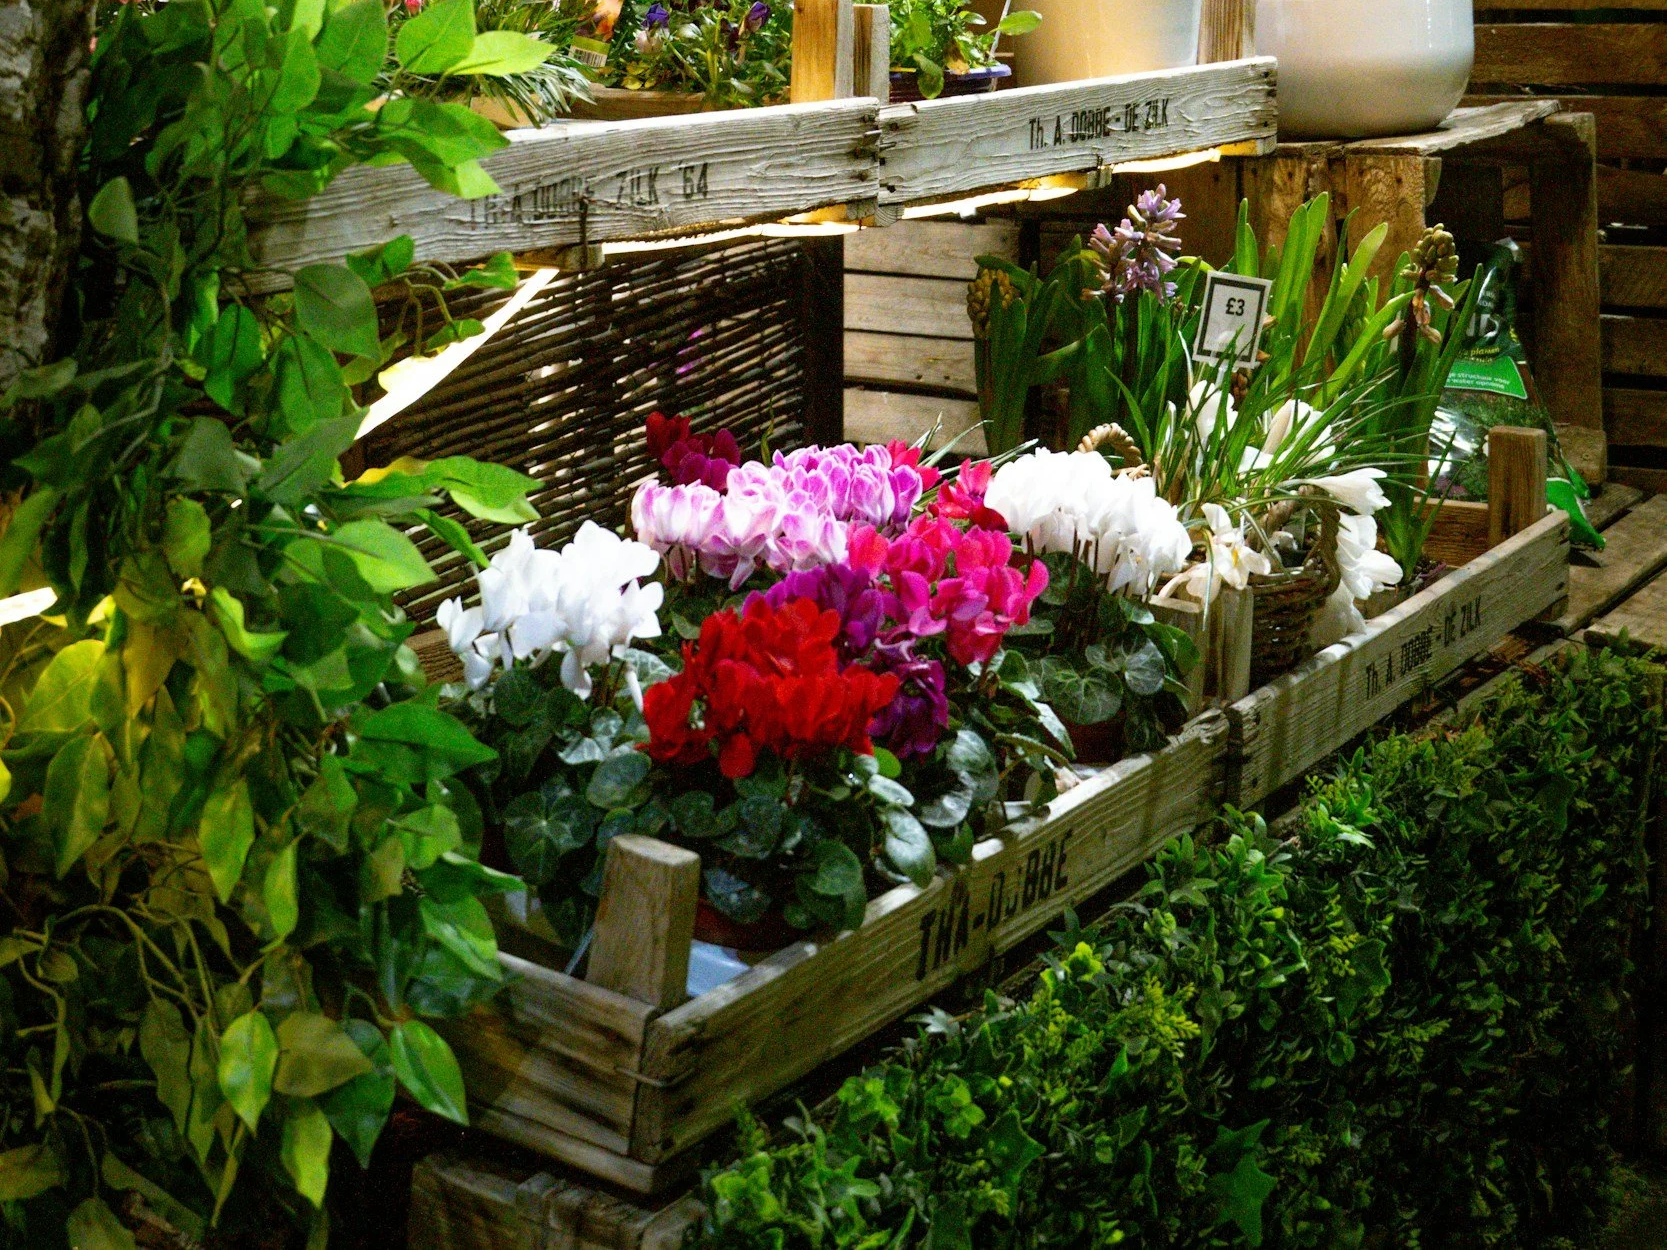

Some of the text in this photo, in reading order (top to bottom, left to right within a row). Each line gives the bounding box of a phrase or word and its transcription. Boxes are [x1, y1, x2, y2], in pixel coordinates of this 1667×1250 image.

[1071, 106, 1111, 143] DOBBE
[1124, 102, 1140, 133] DE
[1144, 98, 1170, 130] ZILK
[615, 165, 660, 211] ZILK
[1225, 297, 1245, 317] £3
[1400, 623, 1432, 677] DOBBE
[1444, 608, 1457, 648] DE
[1461, 594, 1481, 638] ZILK
